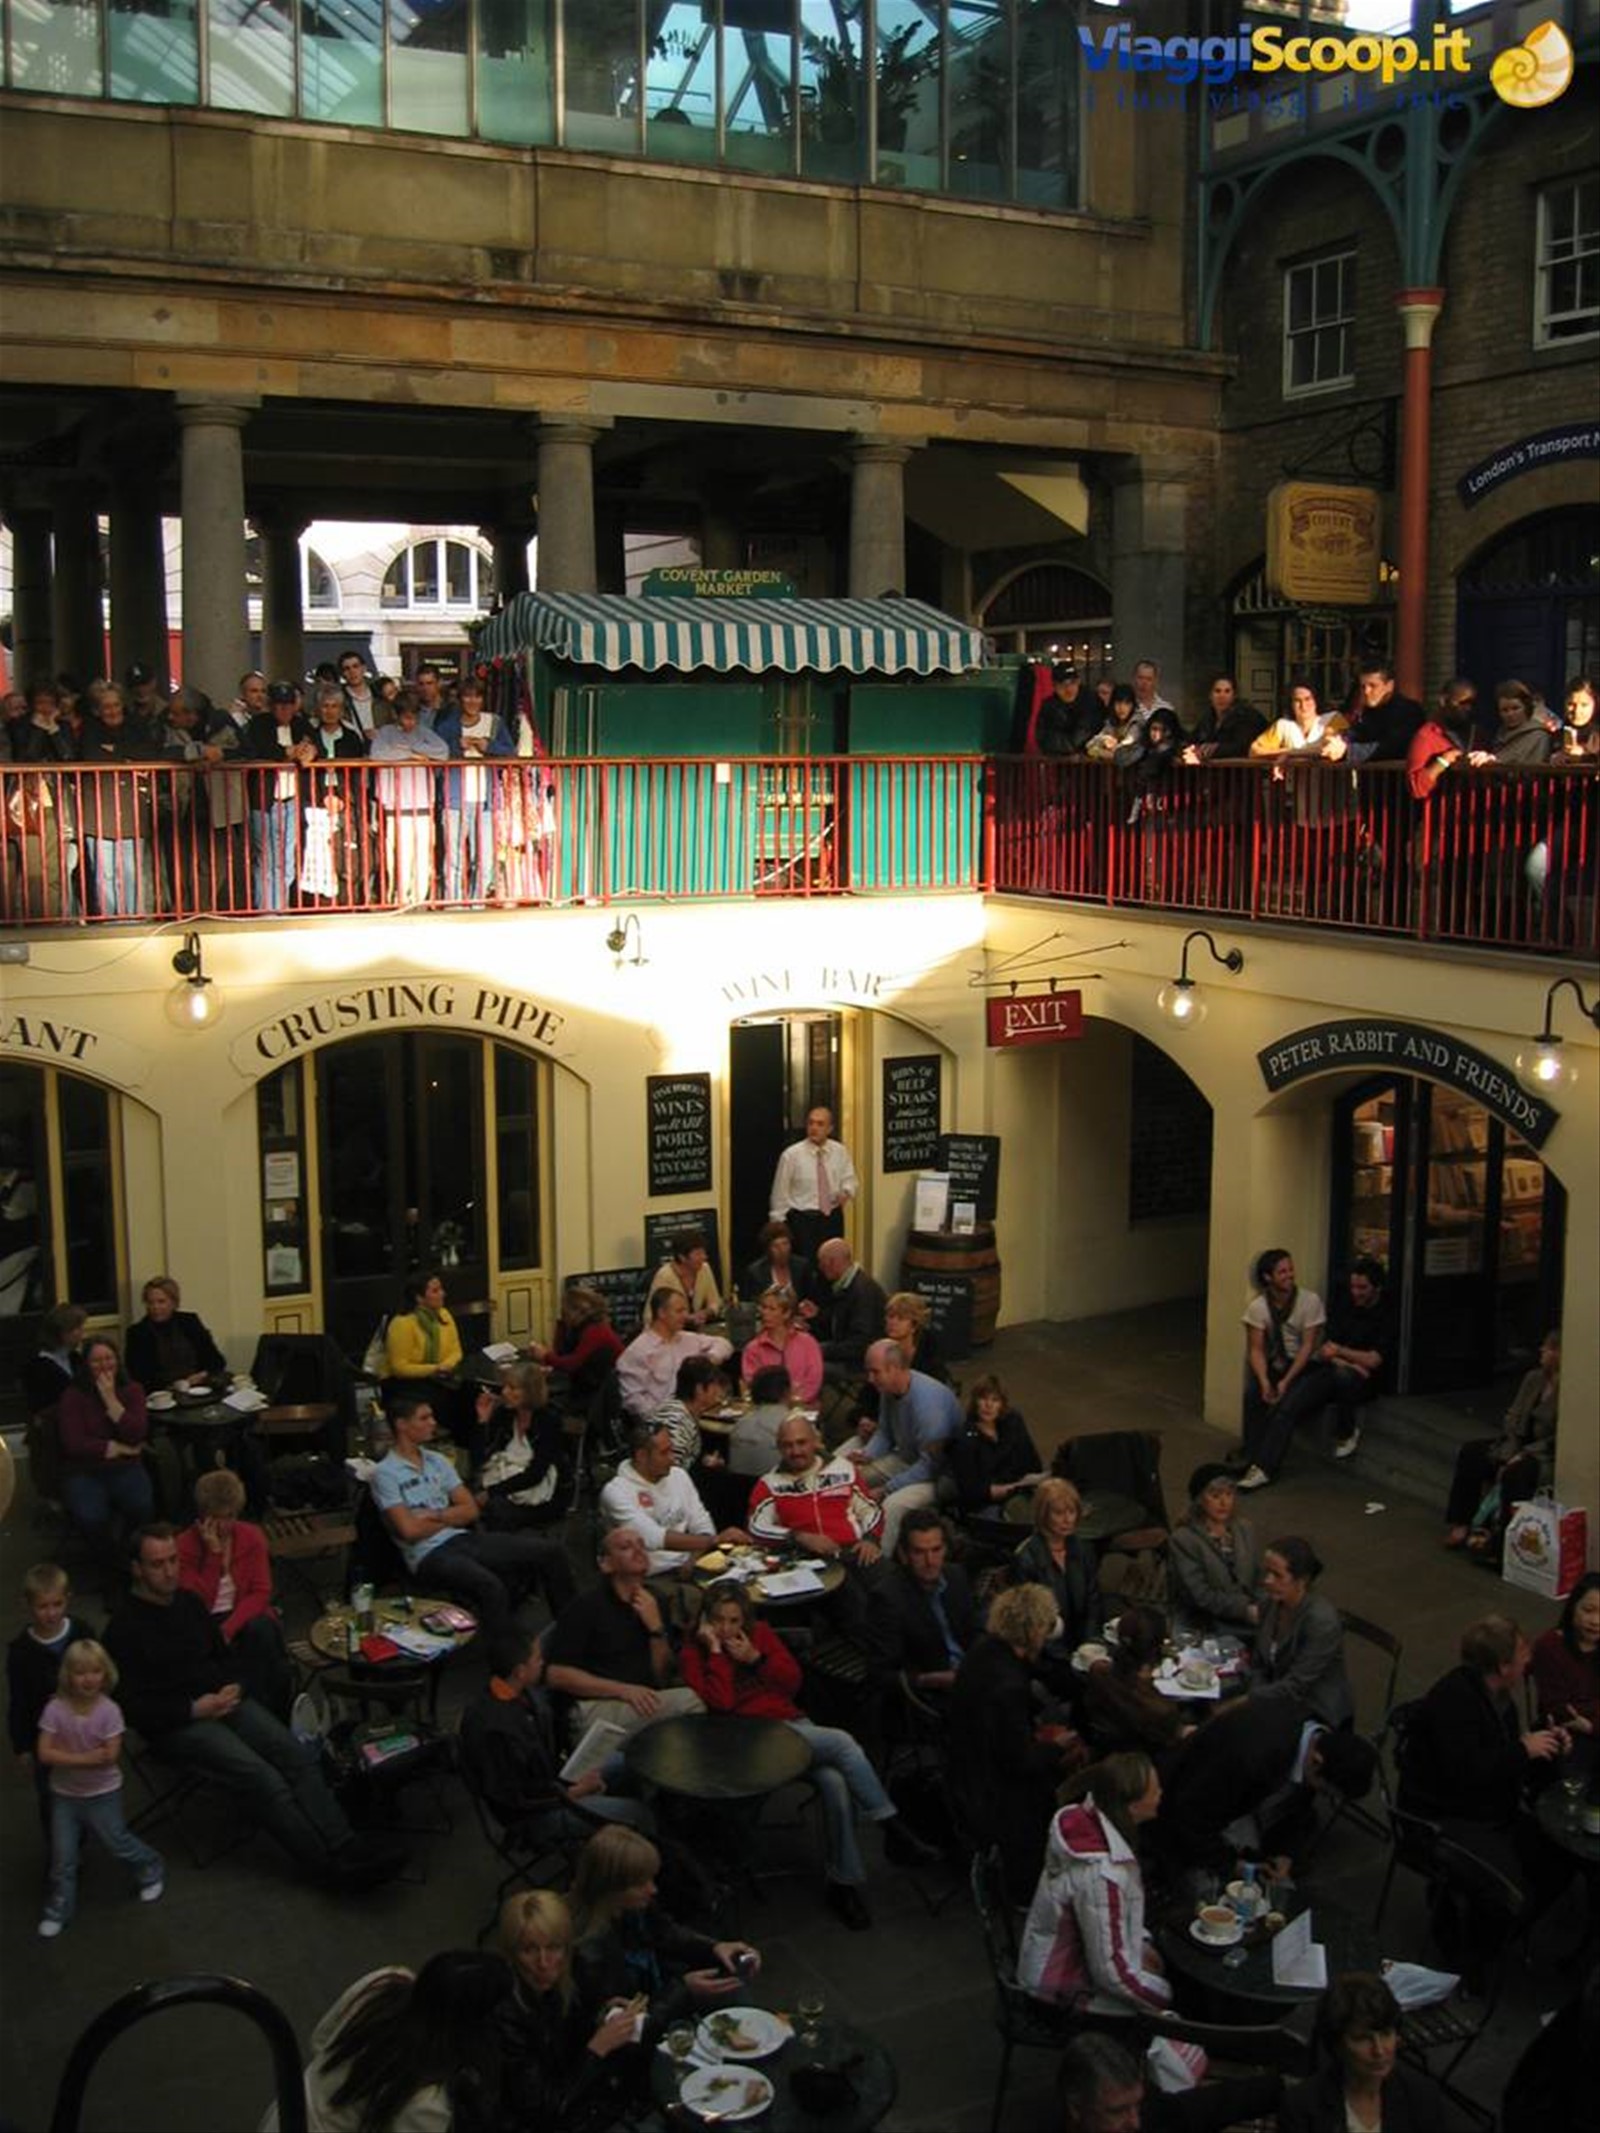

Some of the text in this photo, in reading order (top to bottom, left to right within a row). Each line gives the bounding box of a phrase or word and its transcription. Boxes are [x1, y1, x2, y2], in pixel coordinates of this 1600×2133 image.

[1468, 452, 1525, 492] London's
[1527, 434, 1591, 459] Transport
[660, 569, 781, 583] COVENT GARDEN
[695, 583, 753, 596] MARKET
[256, 983, 565, 1059] CRUSTING PIPE
[1005, 1001, 1067, 1027] EXIT
[0, 1017, 98, 1060] ANT
[1268, 1030, 1540, 1129] PETER RABBIT AND FRIENDS
[888, 1088, 937, 1105] STEAKS
[653, 1099, 706, 1116] WINES
[888, 1117, 937, 1132] CHEESES
[656, 1131, 704, 1149] PORTS
[653, 1160, 708, 1176] VINTAGES
